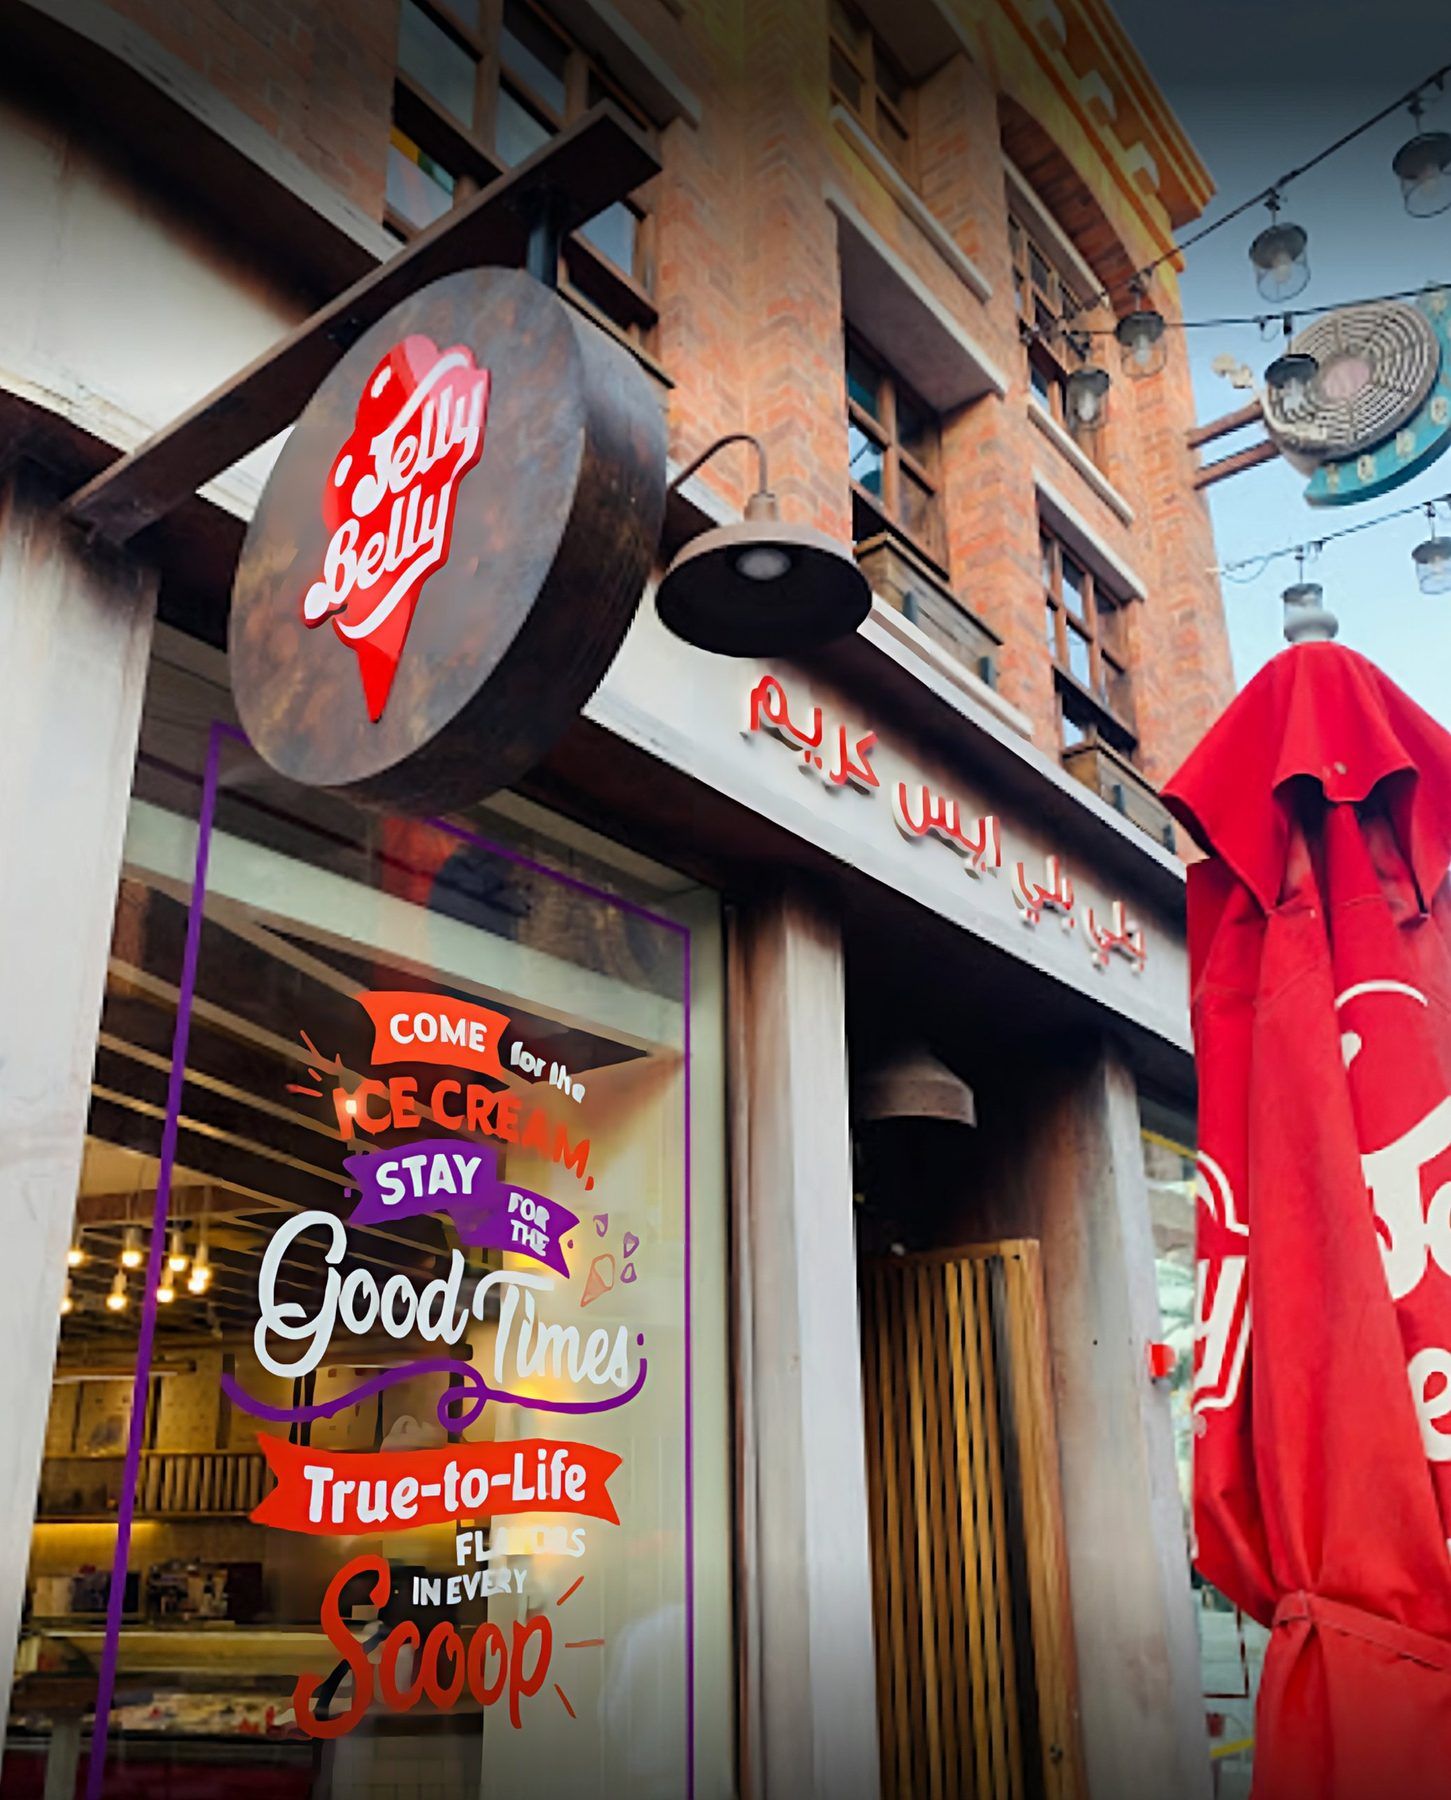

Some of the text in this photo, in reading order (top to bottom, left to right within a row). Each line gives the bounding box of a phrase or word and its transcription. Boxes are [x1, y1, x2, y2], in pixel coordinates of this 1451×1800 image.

[351, 353, 484, 517] Jelly
[303, 479, 452, 639] Belly
[750, 675, 880, 788] كريم
[389, 1012, 487, 1053] COME
[510, 1041, 547, 1077] for
[332, 1076, 594, 1191] ICE CREAM,
[375, 1153, 482, 1206] STAY
[508, 1192, 550, 1233] FOR
[511, 1220, 550, 1258] THE
[254, 1210, 629, 1388] Good Times
[304, 1448, 587, 1524] True-to-Life
[412, 1568, 527, 1606] IN EVERY
[293, 1554, 553, 1739] Scoop
